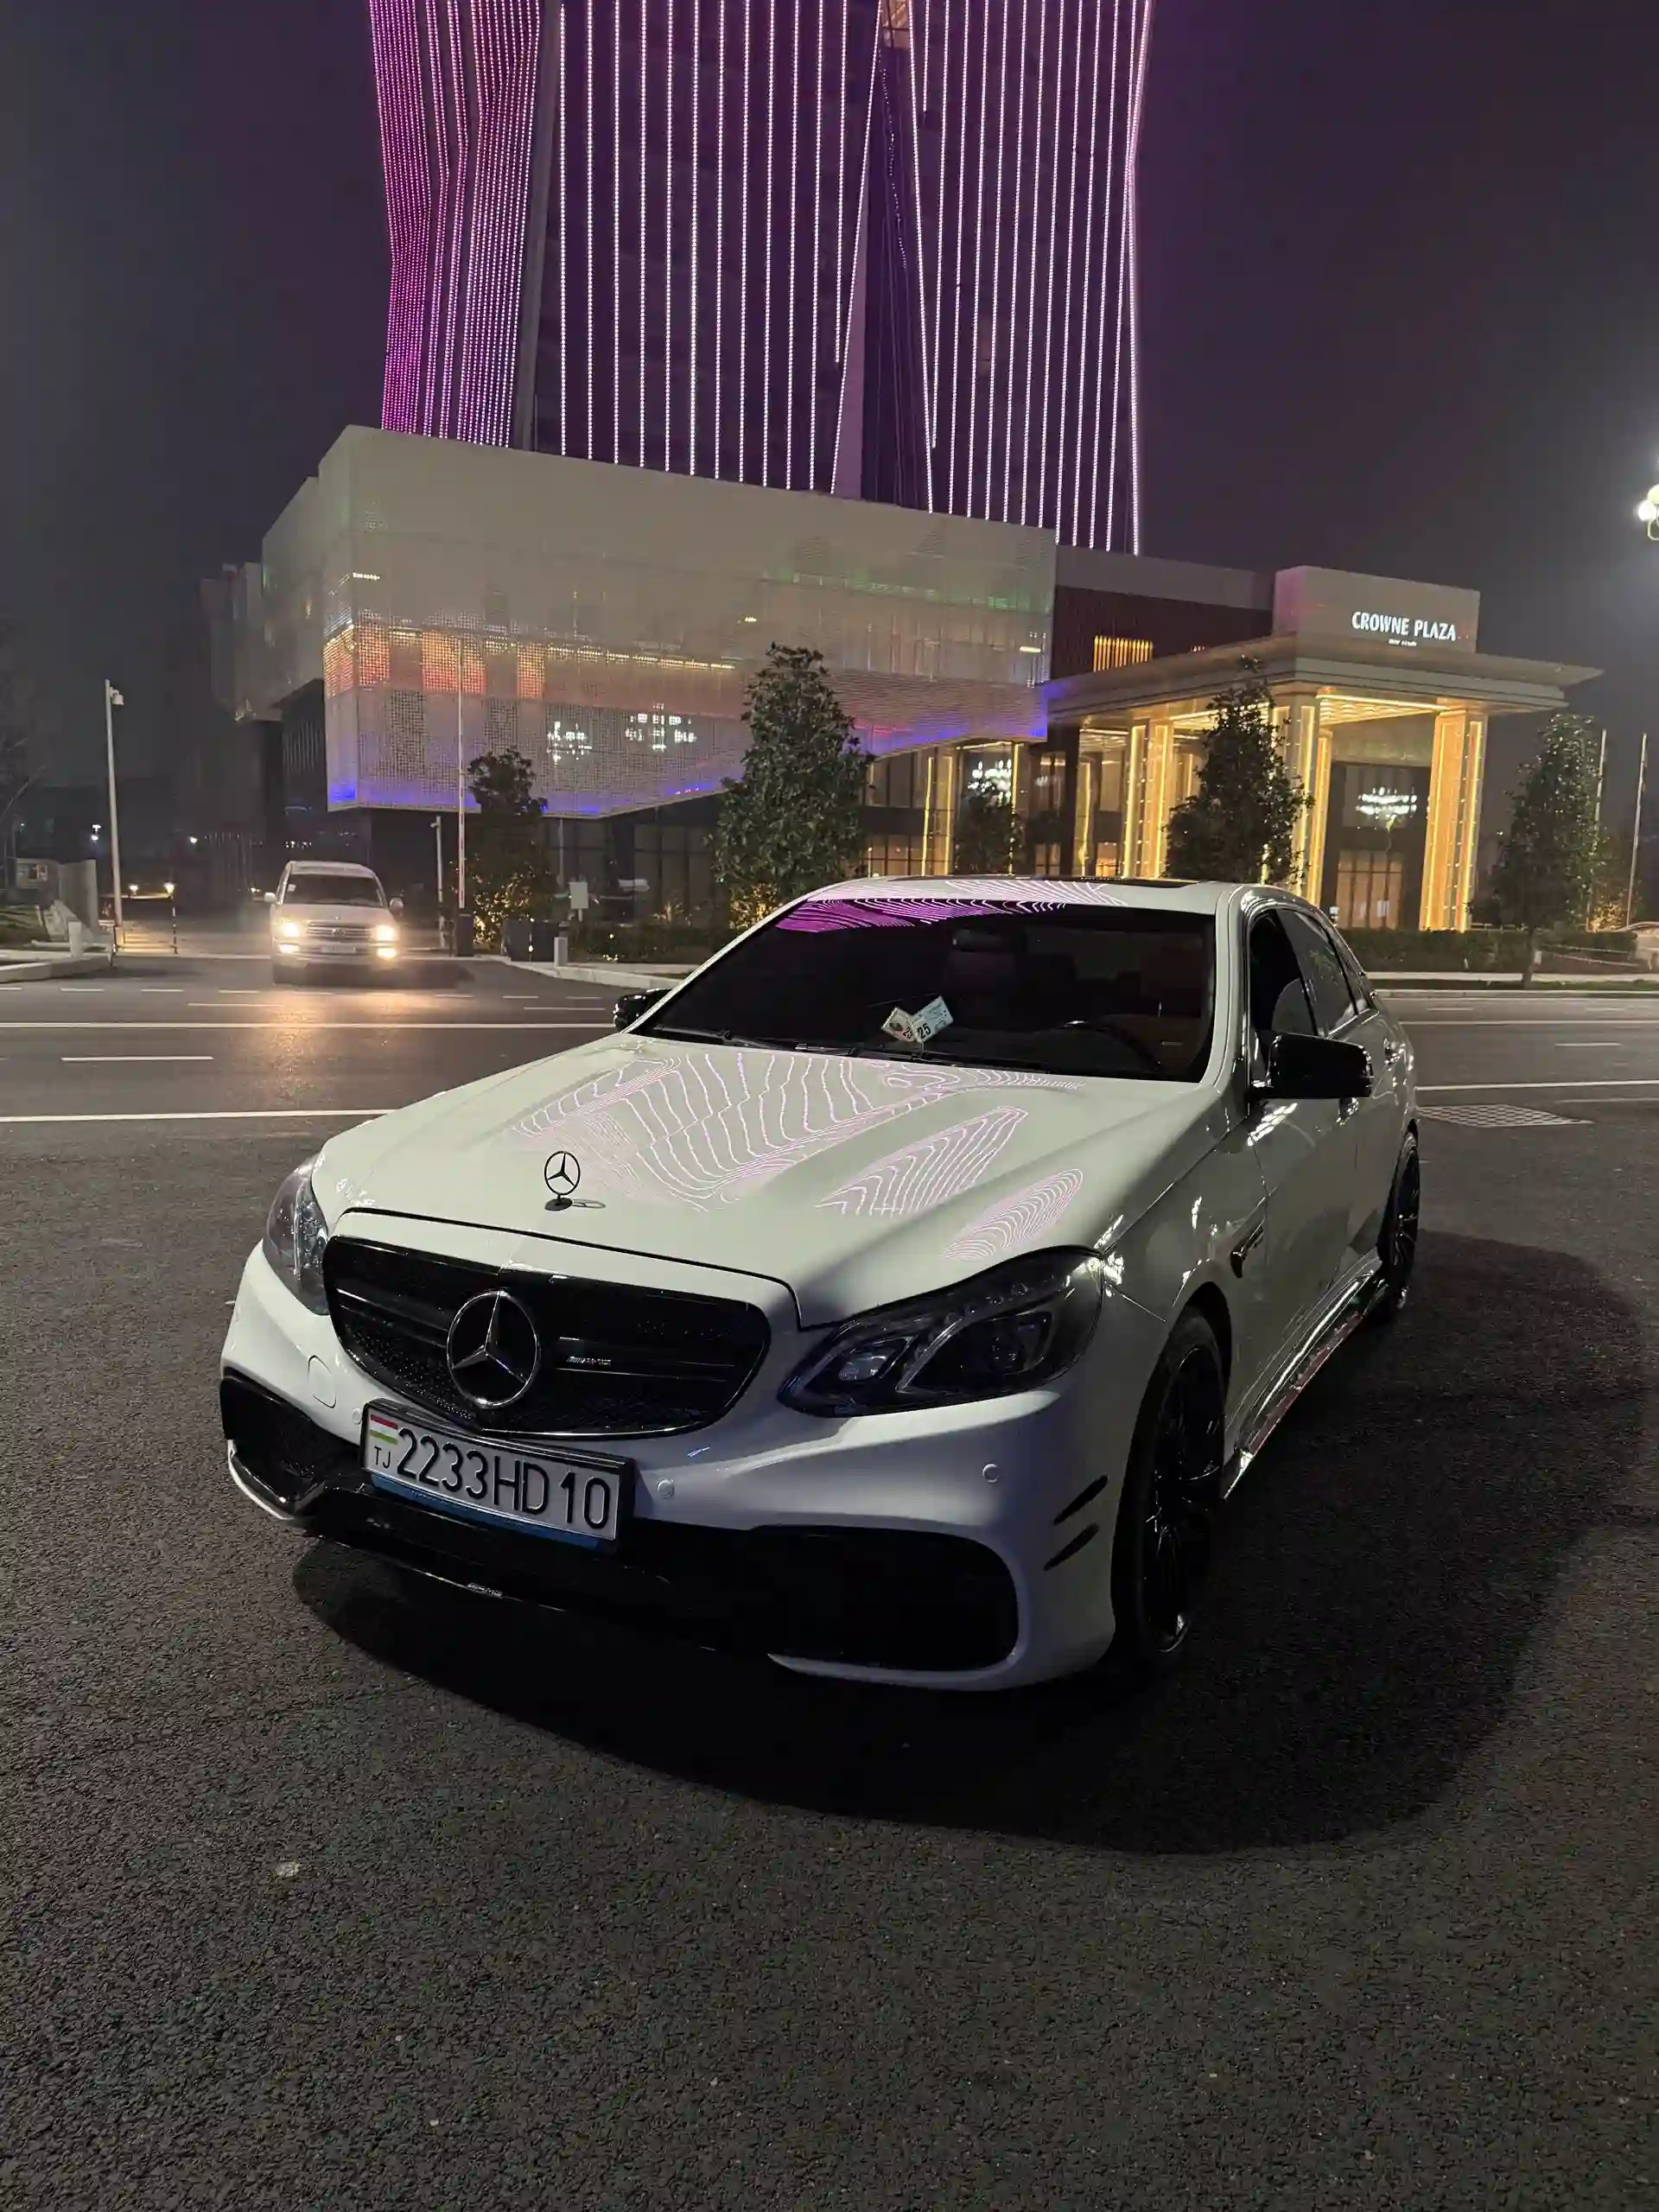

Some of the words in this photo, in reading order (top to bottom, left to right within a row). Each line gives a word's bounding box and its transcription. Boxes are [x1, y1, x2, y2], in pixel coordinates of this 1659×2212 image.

[1351, 611, 1410, 636] CROWNE
[1414, 620, 1457, 641] PLAZA
[917, 1022, 931, 1039] 25
[373, 1446, 391, 1470] TJ
